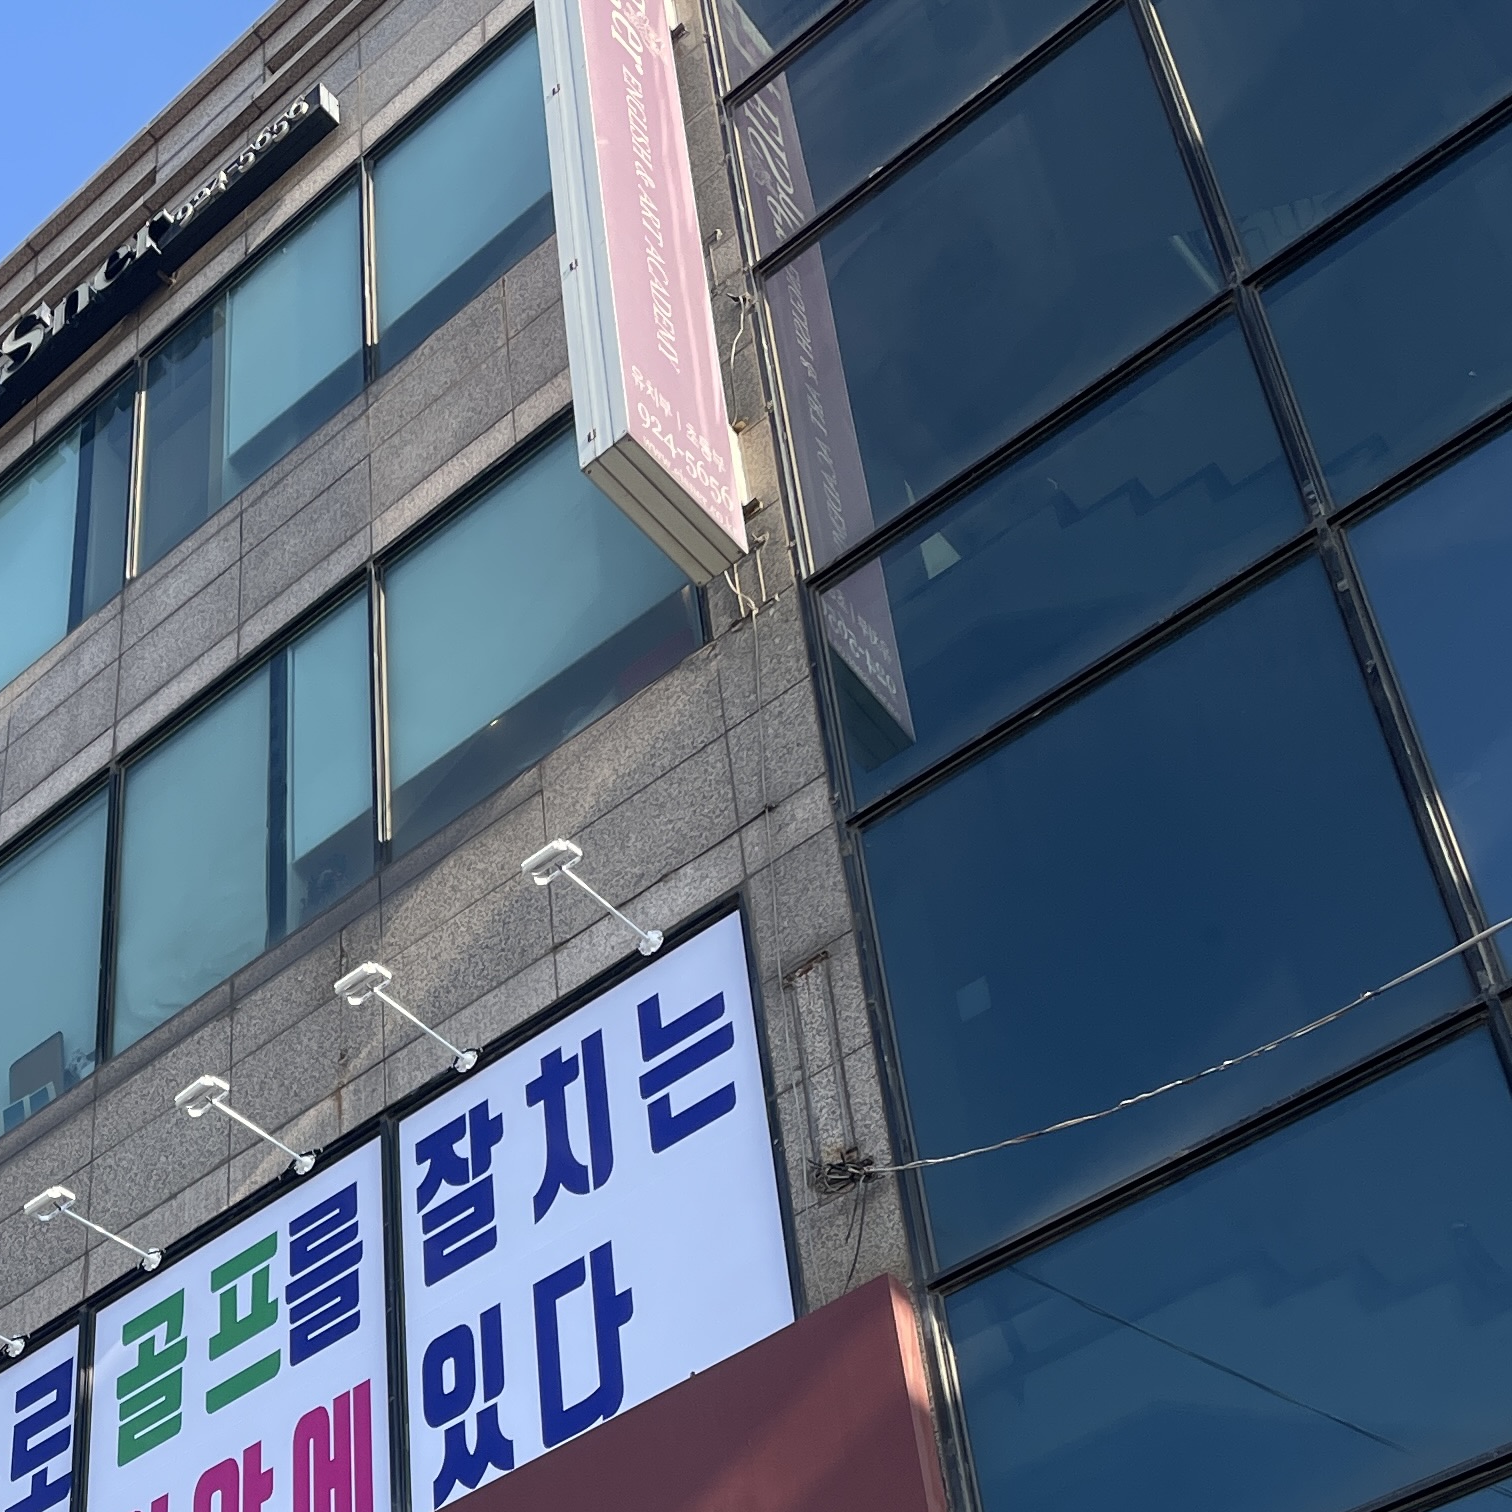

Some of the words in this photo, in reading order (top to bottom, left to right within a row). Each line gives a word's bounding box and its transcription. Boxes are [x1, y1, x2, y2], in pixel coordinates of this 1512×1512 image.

[176, 95, 310, 229] 924-5656
[622, 64, 653, 172] ENGLISH
[637, 184, 663, 247] ART
[644, 243, 680, 375] ACADEMY
[631, 365, 673, 418] 유치부
[637, 402, 734, 513] 924-5656
[116, 1181, 363, 1468] 골프를
[414, 990, 737, 1288] 잘치는
[421, 1239, 635, 1512] 있다
